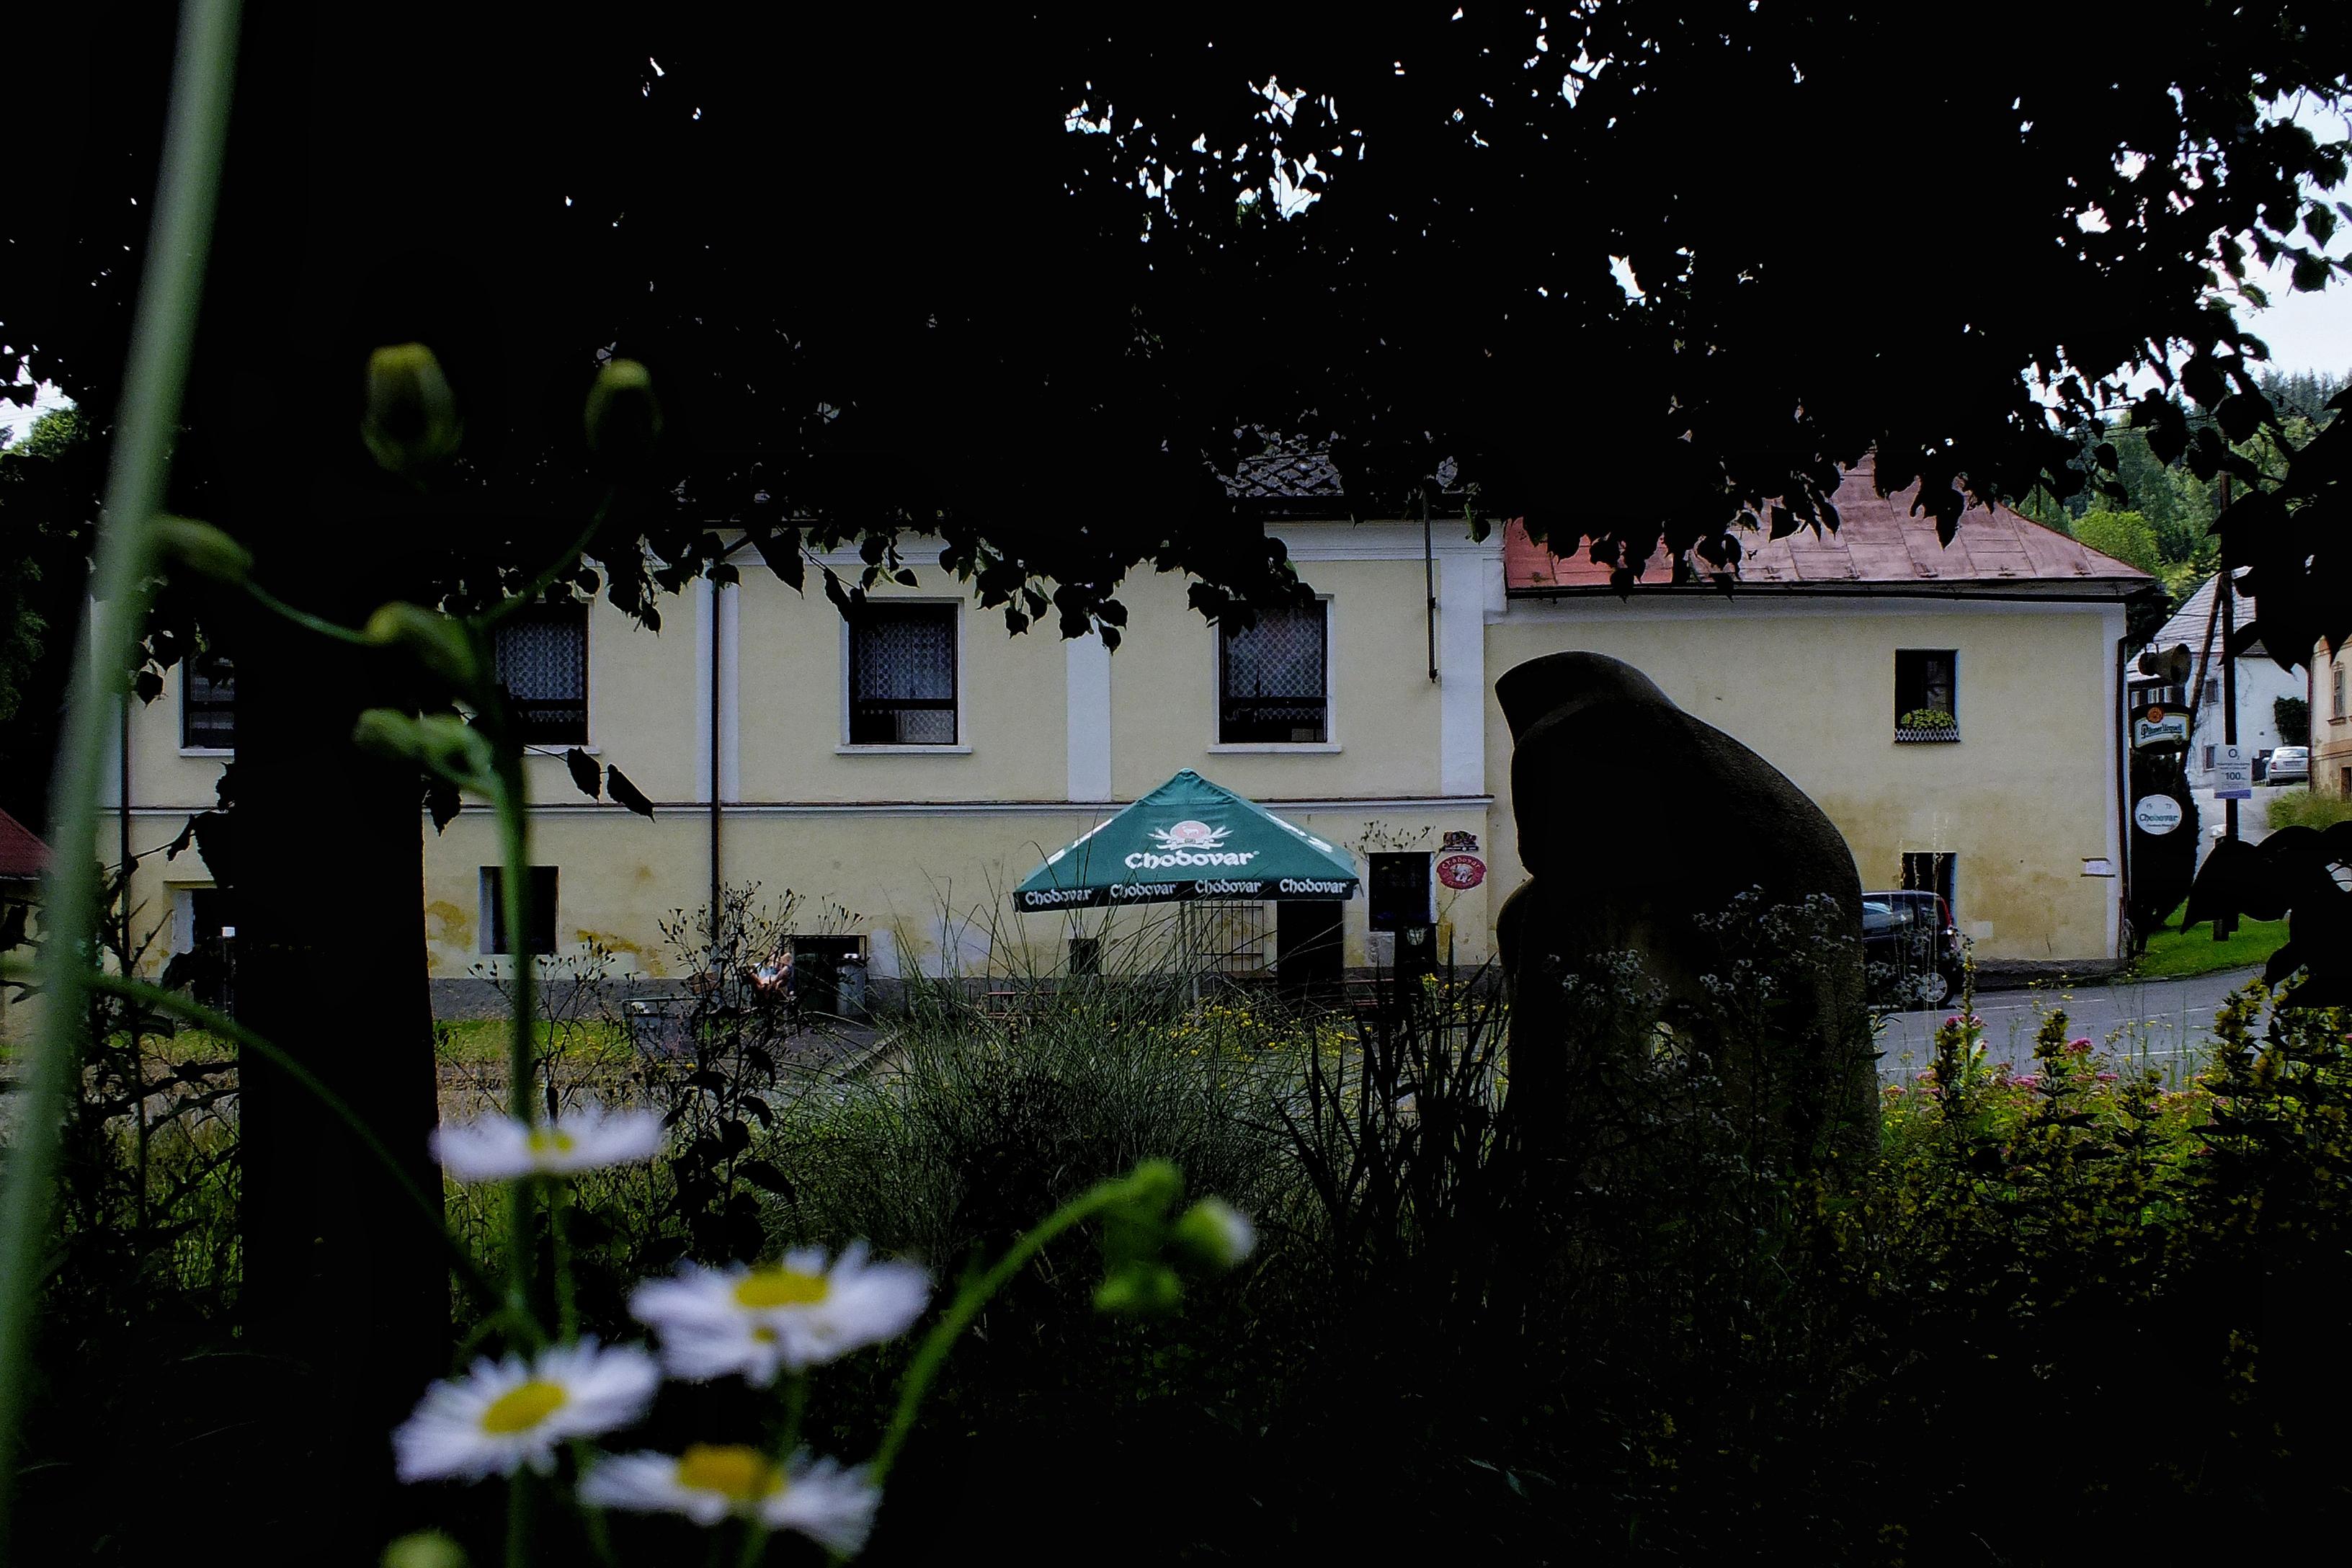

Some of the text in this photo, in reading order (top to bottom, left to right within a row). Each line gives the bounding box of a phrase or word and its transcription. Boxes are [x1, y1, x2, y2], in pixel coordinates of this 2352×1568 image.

[2225, 772, 2240, 780] 100
[1124, 850, 1254, 869] Chodovar
[1025, 888, 1092, 906] Chodovar
[1195, 879, 1262, 895] Chodovar
[1279, 878, 1347, 894] Chodovar
